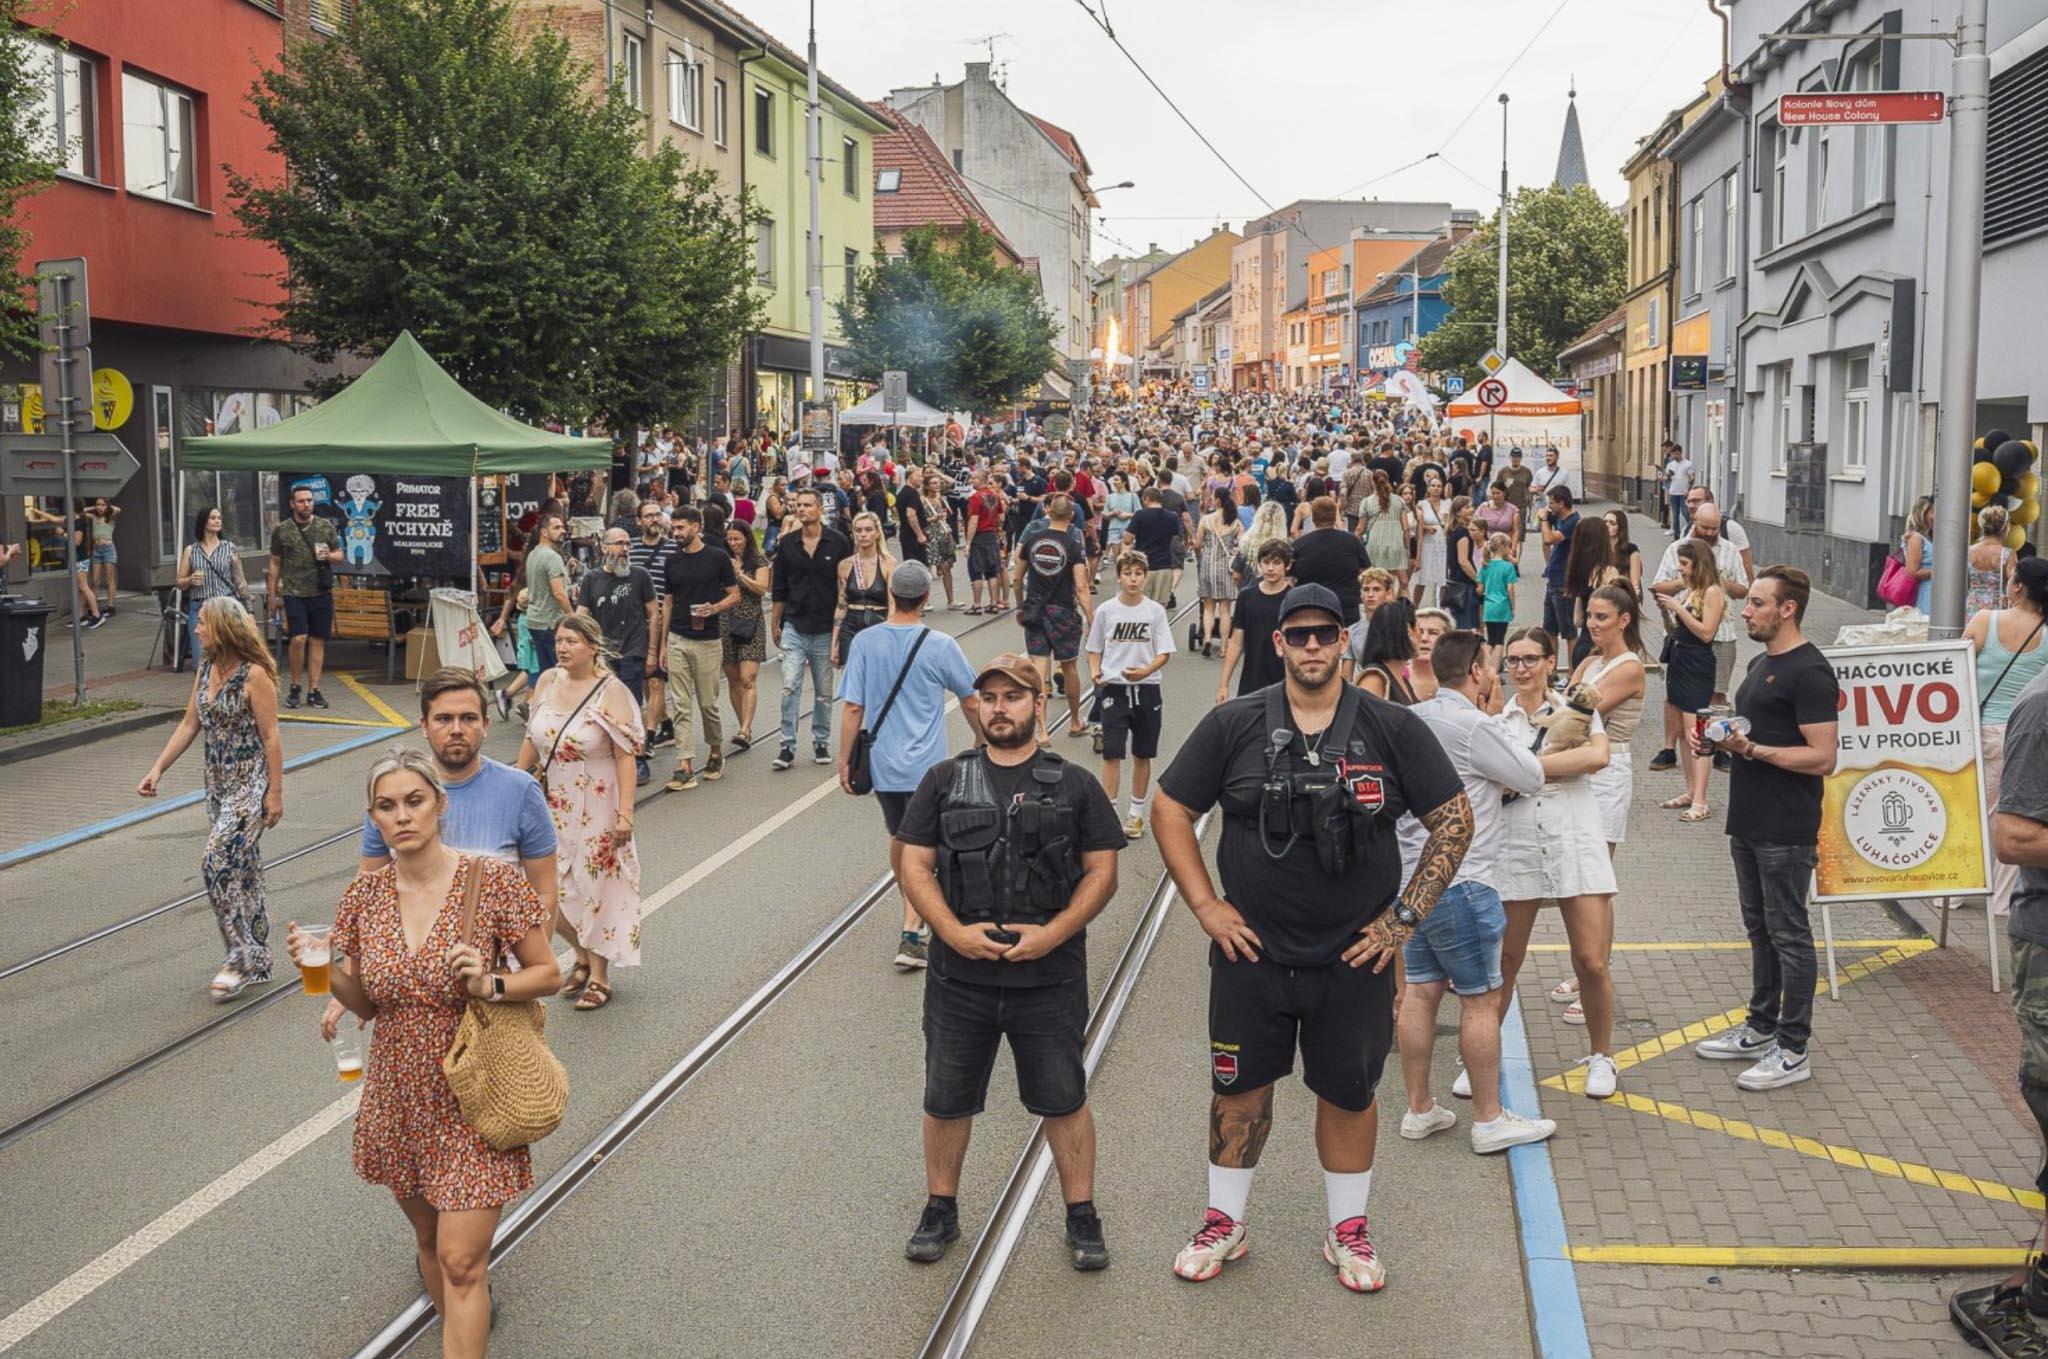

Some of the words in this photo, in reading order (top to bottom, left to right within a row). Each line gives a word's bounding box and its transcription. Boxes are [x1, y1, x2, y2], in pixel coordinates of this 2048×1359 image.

[1784, 100, 1823, 110] Kolonie
[1826, 100, 1852, 110] Nový
[1855, 99, 1877, 108] dům
[1783, 112, 1806, 121] New
[1808, 112, 1841, 121] House
[1843, 111, 1880, 122] Colony
[1495, 427, 1571, 449] everka
[395, 503, 441, 518] FREE
[385, 519, 453, 537] TCHYNĚ
[1113, 622, 1149, 640] NIKE
[1836, 658, 1954, 680] HAČOVICKÉ
[1858, 734, 1871, 750] V
[1877, 730, 1961, 749] PRODEJI
[1357, 782, 1379, 792] BIG
[1899, 776, 1939, 814] PIVOVAR
[1855, 832, 1939, 865] LUHAČOVICE
